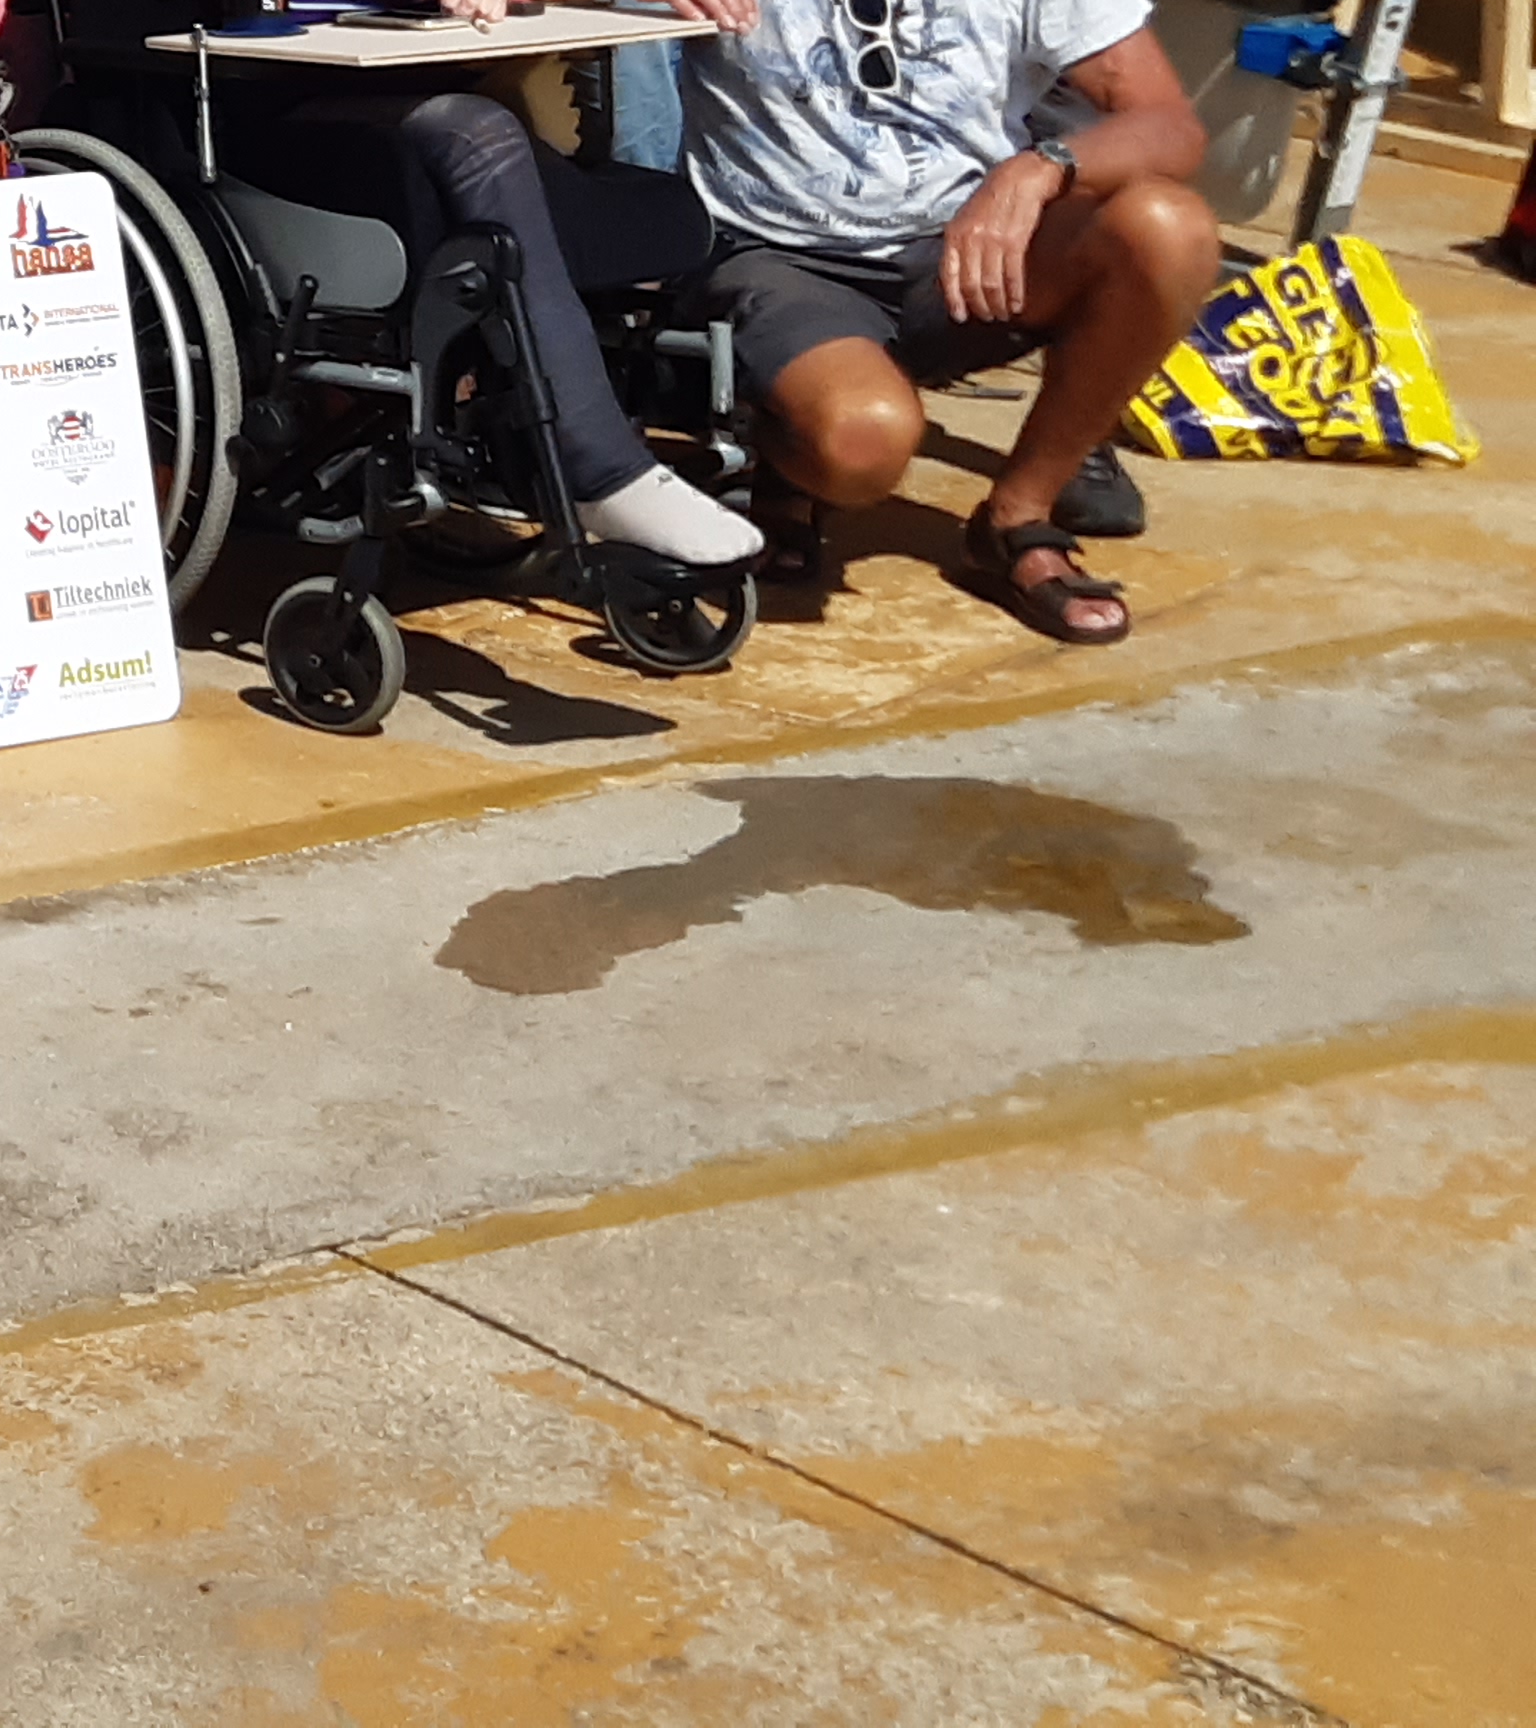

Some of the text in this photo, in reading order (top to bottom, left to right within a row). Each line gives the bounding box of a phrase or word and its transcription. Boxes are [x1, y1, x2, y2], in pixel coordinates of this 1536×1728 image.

[58, 500, 131, 539] lopital
[52, 574, 154, 609] Tiltechniek
[58, 649, 154, 688] Adsum!
